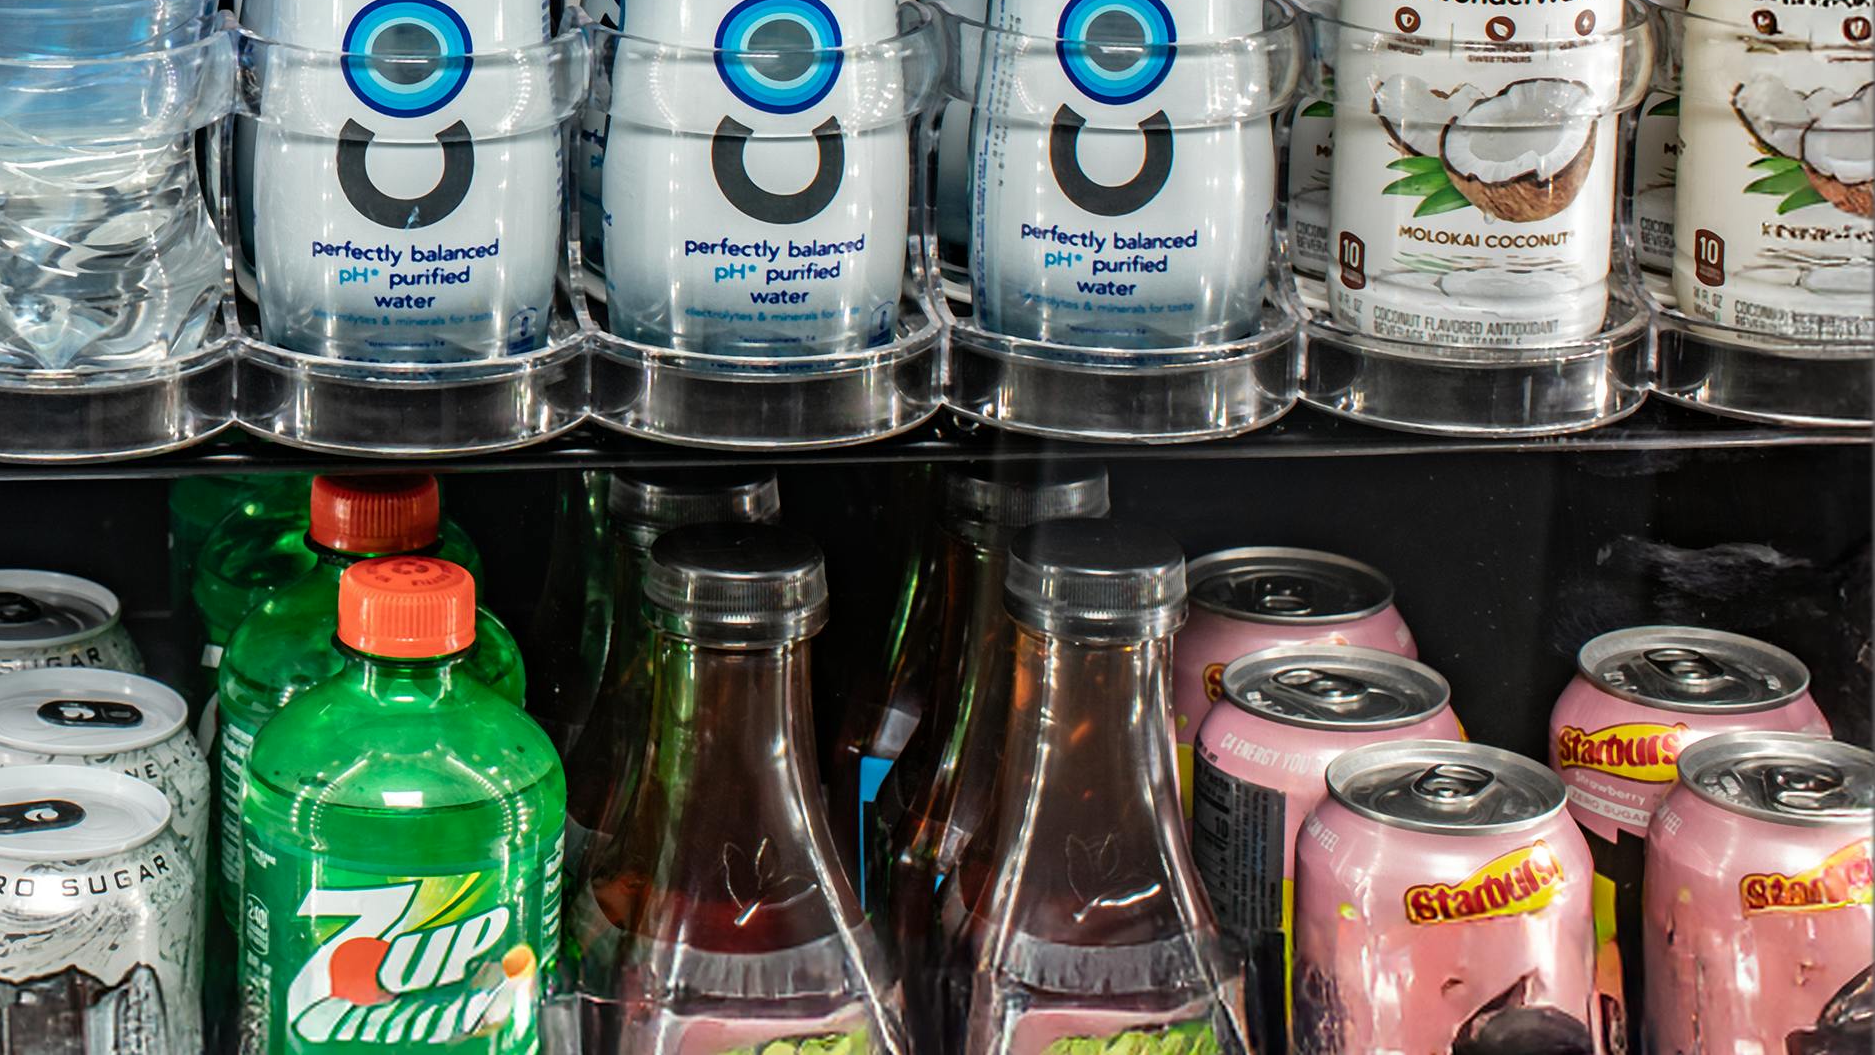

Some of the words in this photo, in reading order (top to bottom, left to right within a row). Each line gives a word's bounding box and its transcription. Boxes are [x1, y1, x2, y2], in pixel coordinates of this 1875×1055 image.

[684, 237, 780, 263] perfectly
[788, 233, 866, 258] balanced
[1021, 223, 1107, 254] perfectly
[1113, 230, 1198, 251] balanced
[1399, 225, 1480, 247] MOLOKAI
[1485, 231, 1567, 250] COCONUT
[1699, 237, 1719, 266] 10
[312, 239, 403, 268] perfectly
[410, 238, 500, 263] balanced
[1092, 255, 1168, 276] purified
[1343, 239, 1359, 268] 10
[389, 265, 471, 290] purified
[766, 261, 841, 286] purified
[374, 294, 436, 310] water
[750, 289, 809, 305] water
[1076, 280, 1137, 297] water
[1233, 739, 1280, 767] ENERGY
[1559, 727, 1681, 767] Starburs
[1575, 770, 1646, 806] Strawberry
[62, 853, 170, 897] SUGAR
